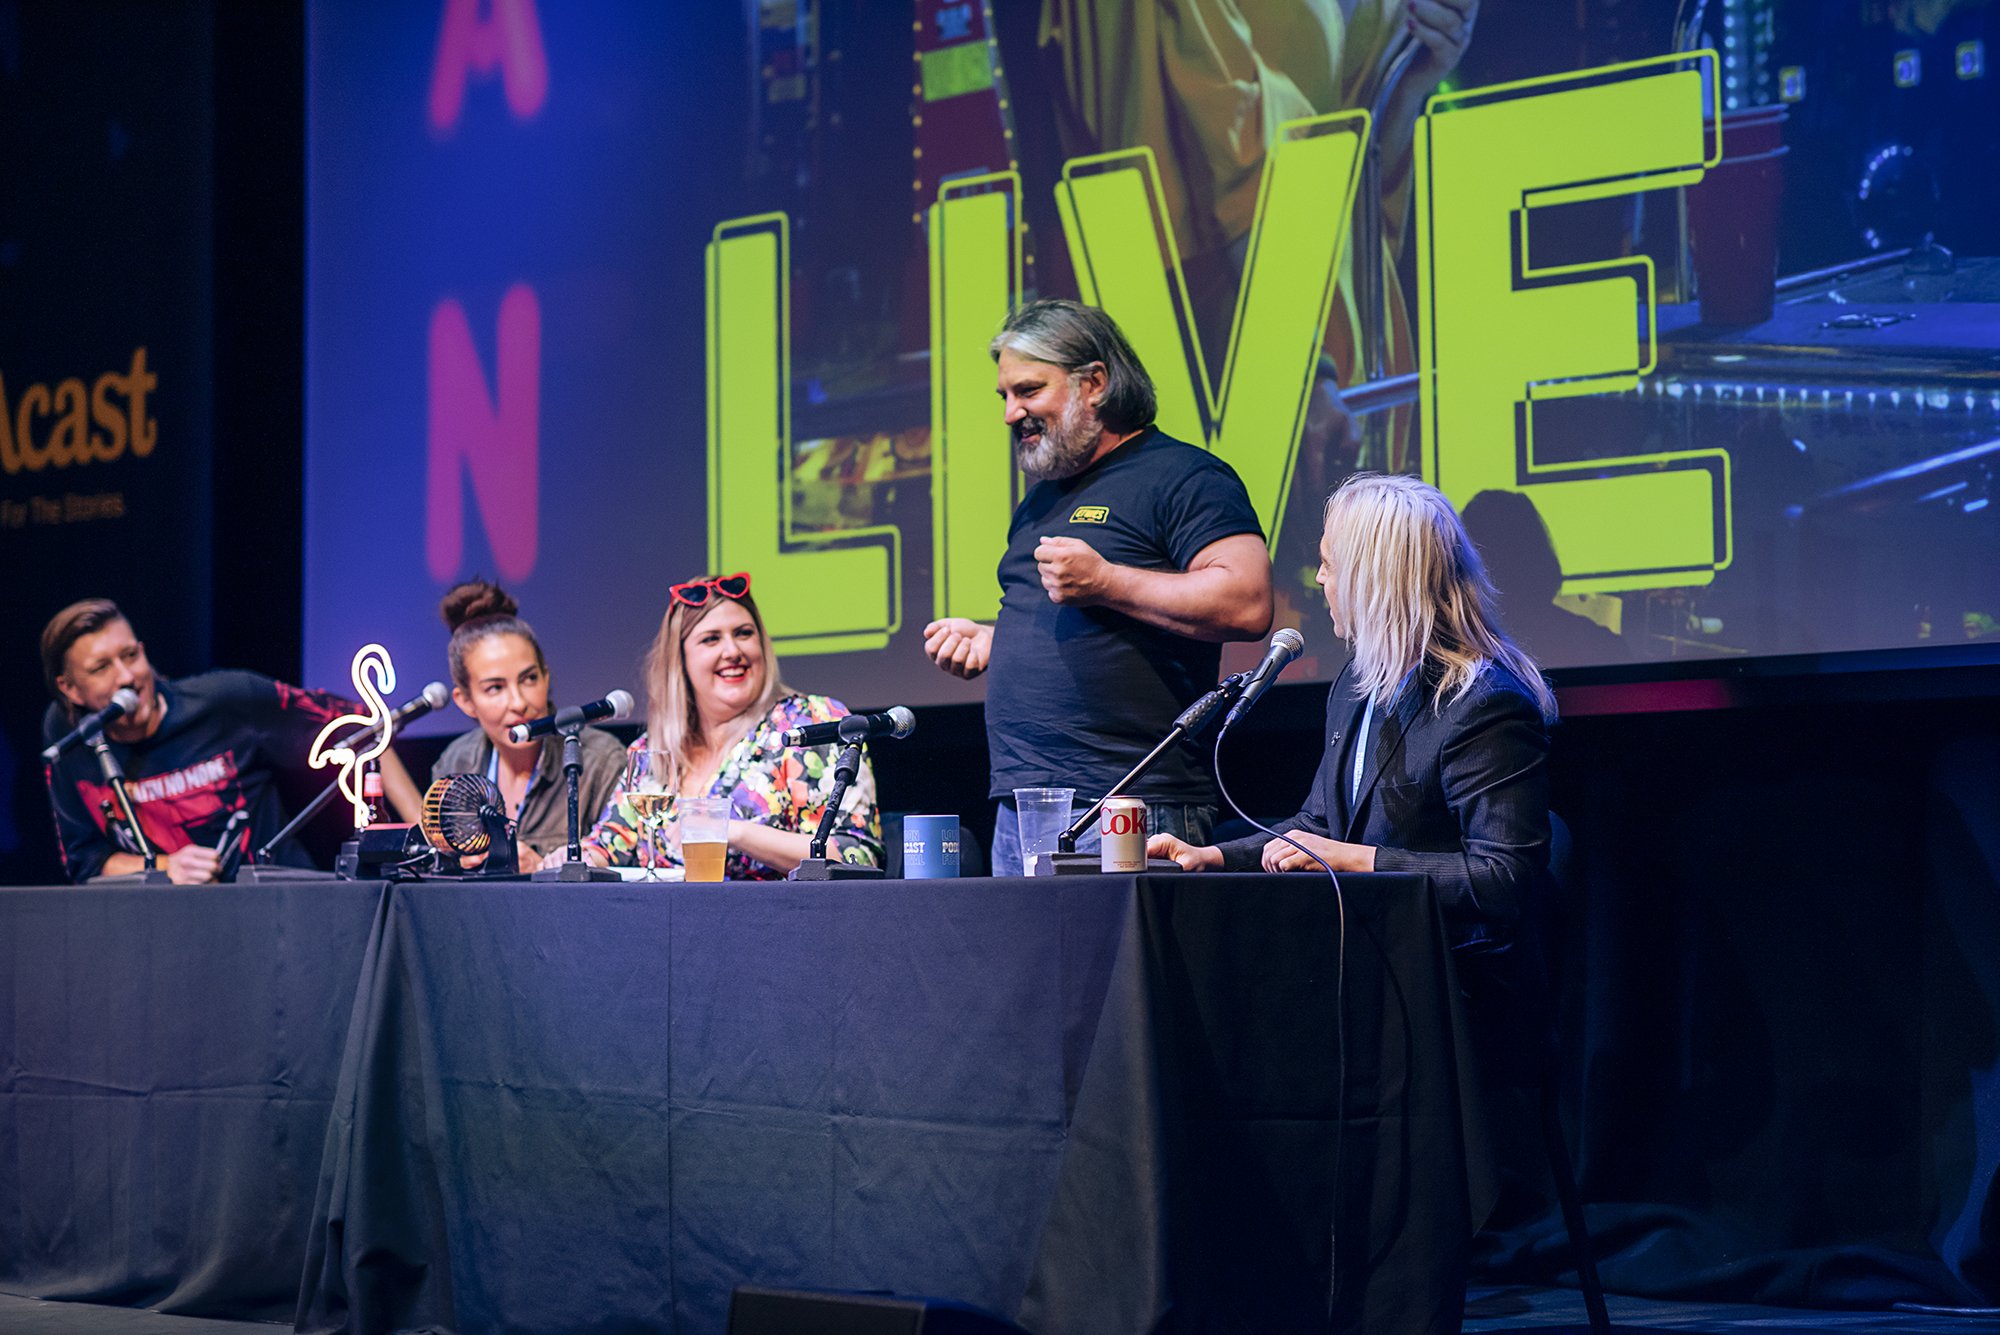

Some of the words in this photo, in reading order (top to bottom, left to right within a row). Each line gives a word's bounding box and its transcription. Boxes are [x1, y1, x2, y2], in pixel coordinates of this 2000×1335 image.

[705, 47, 1733, 657] LIVE
[164, 770, 187, 796] NO
[1101, 806, 1148, 836] Cok
